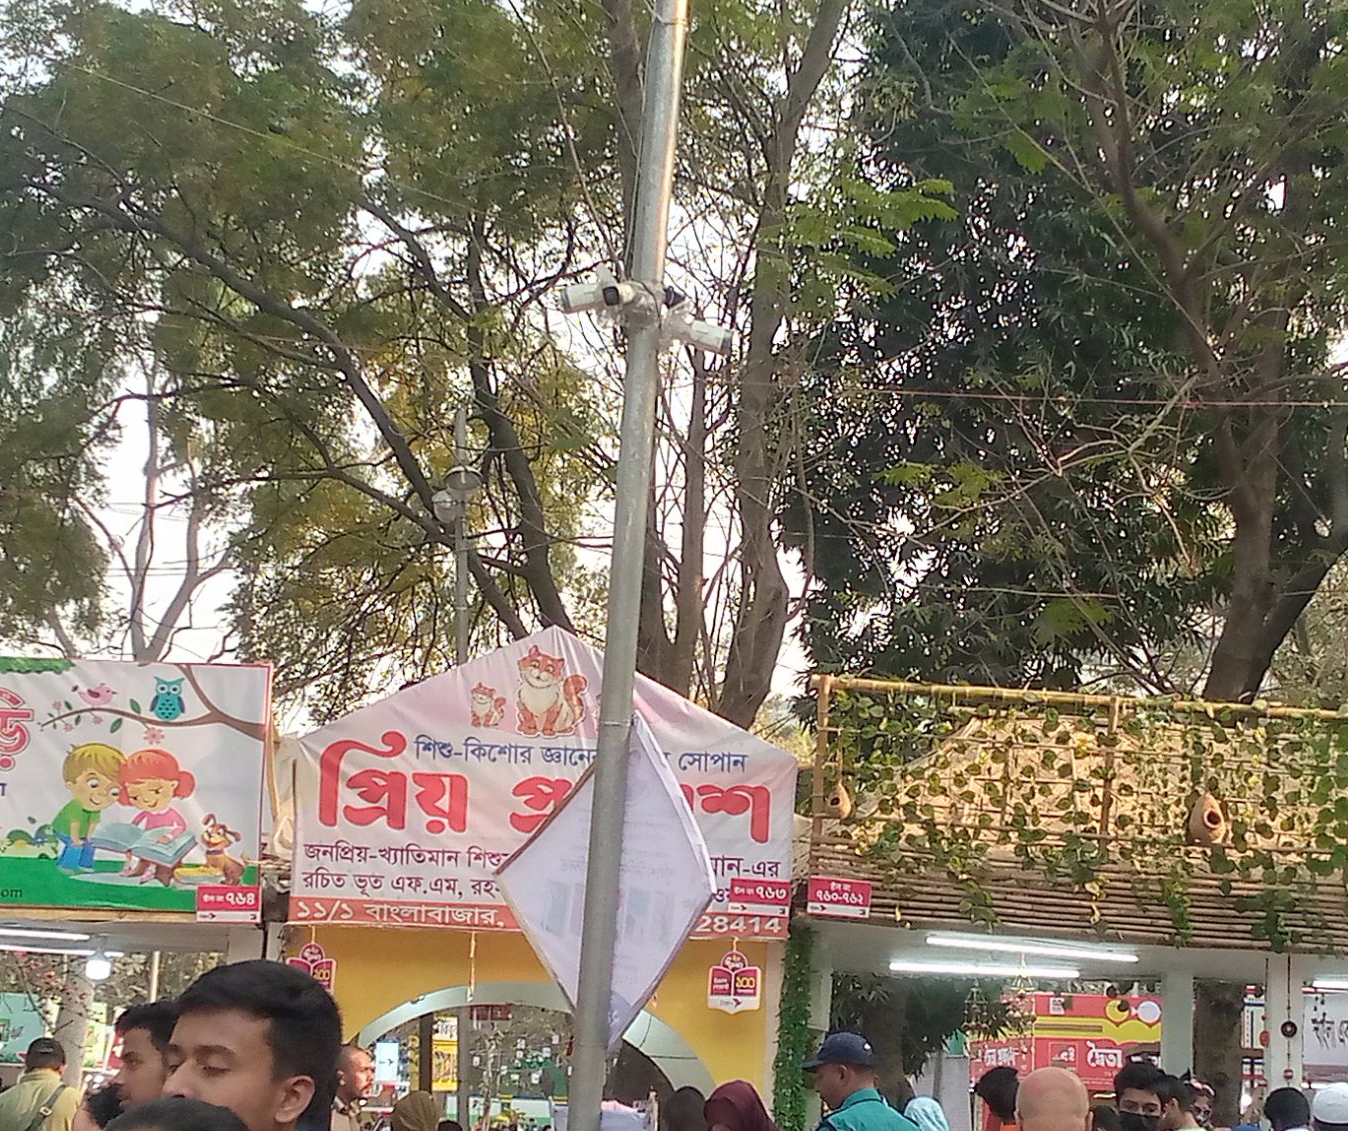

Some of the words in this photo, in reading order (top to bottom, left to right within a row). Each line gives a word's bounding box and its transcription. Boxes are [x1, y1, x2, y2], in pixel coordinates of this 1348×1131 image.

[414, 734, 532, 763] শিশু-কিশোর
[679, 751, 748, 773] সোপান
[319, 730, 468, 833] প্রিয়
[304, 840, 459, 865] জনপ্রিয়-খ্যাতিমান
[466, 845, 508, 868] শিশু
[302, 867, 345, 889] রচিত
[353, 871, 383, 898] ভূত
[755, 886, 787, 899] ৭৬৩
[225, 892, 255, 905] ৭৬৪
[816, 890, 863, 905] ৭৬০-৭৬২
[296, 900, 354, 921] ১১/১
[695, 915, 782, 934] 28414
